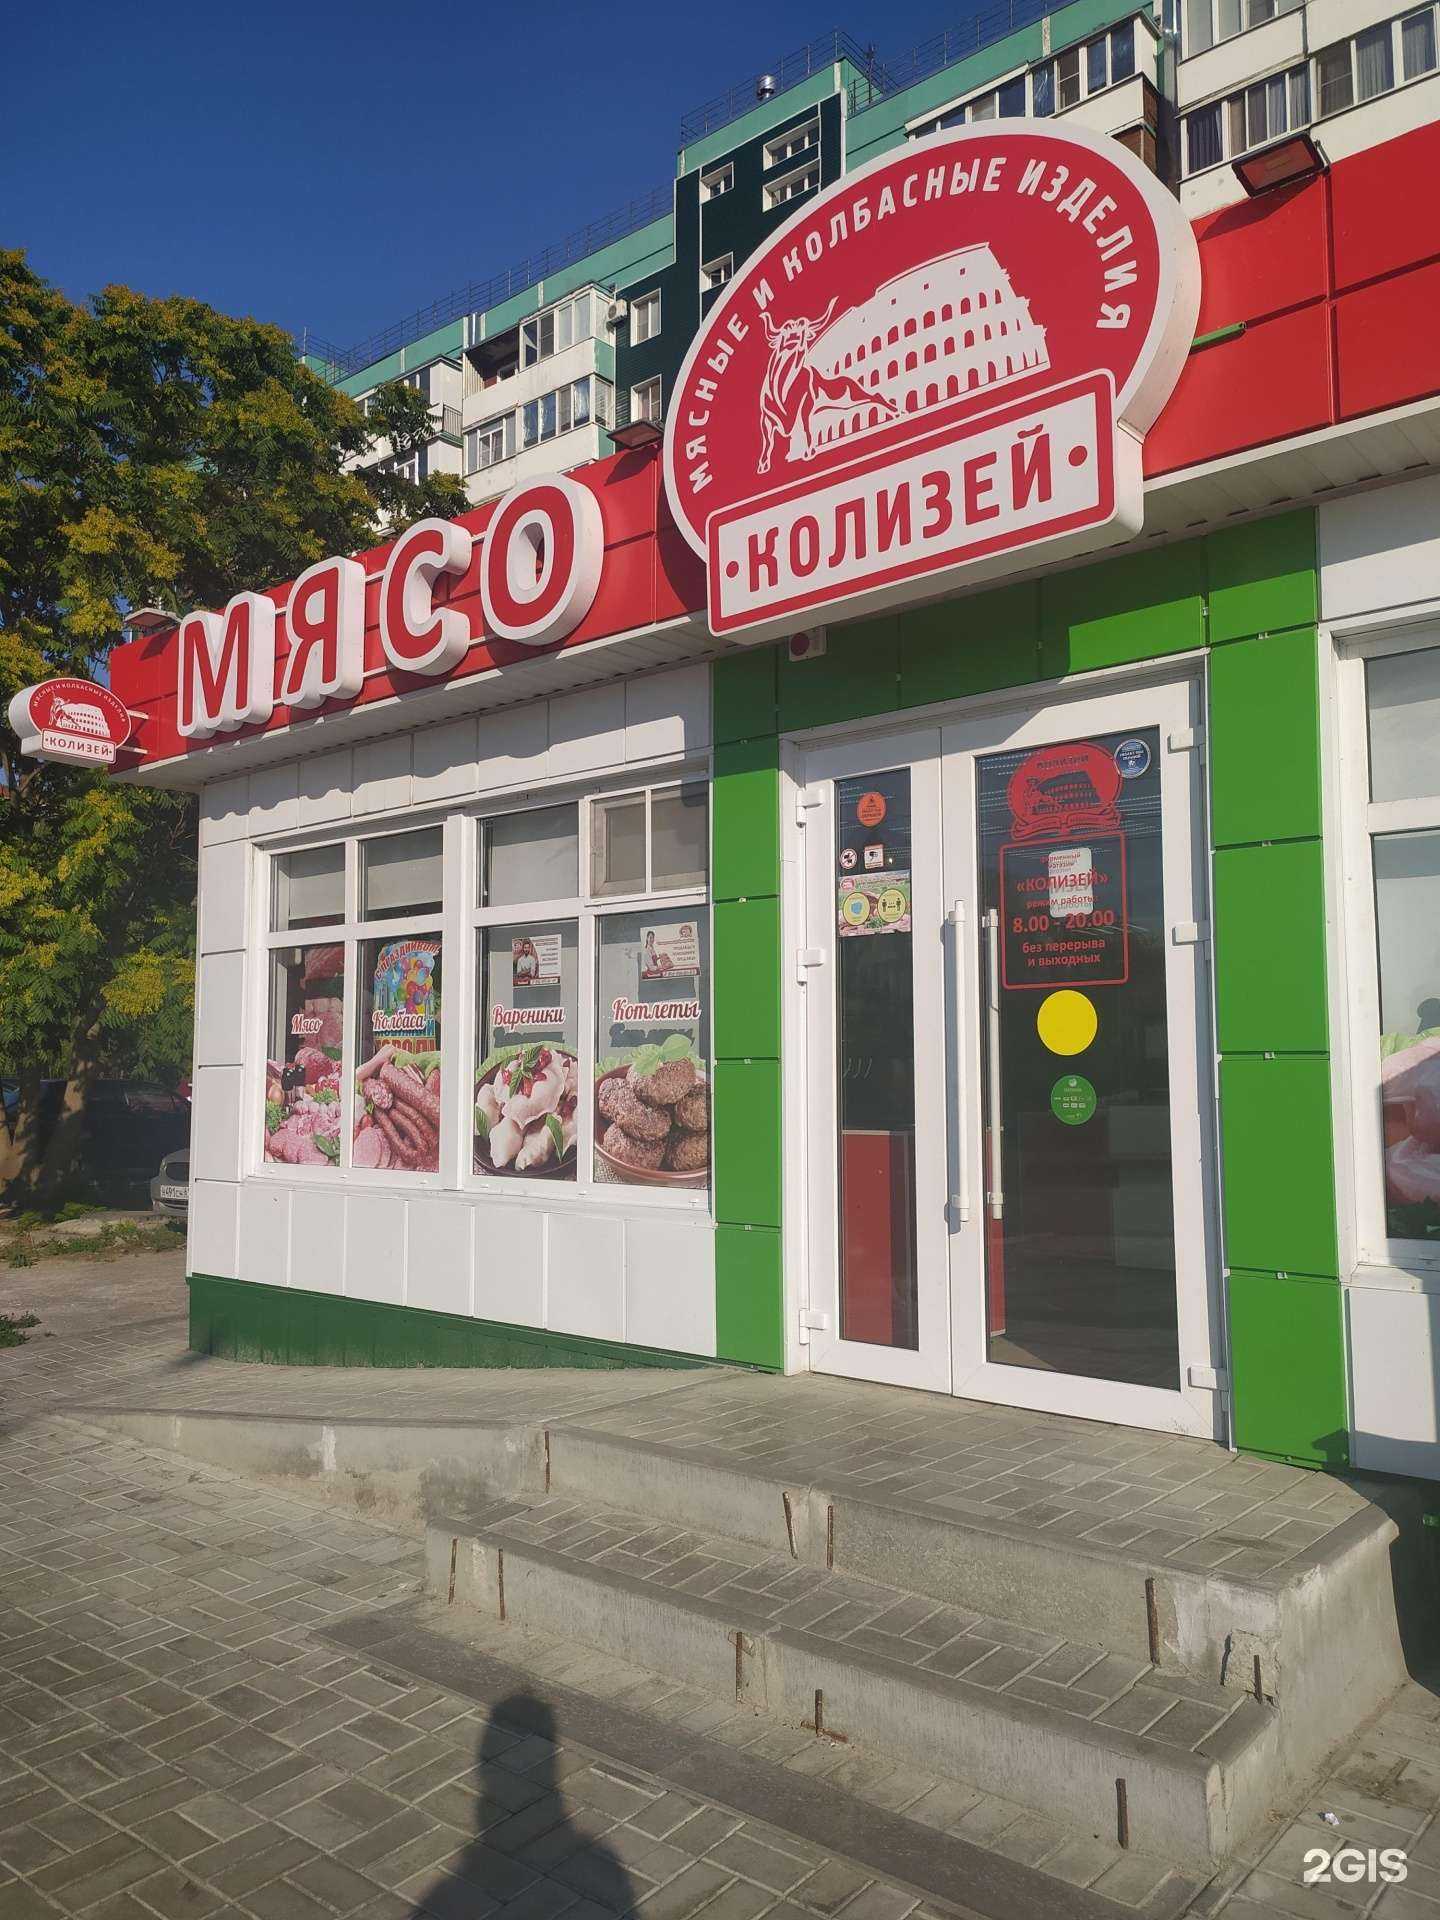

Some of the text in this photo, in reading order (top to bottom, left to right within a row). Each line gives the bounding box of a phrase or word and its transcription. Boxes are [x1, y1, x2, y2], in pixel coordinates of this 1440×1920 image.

[685, 157, 1138, 493] МЯСНЫЕ И КОЛБАСНЫЕ ИЗДЕЛИЯ
[747, 423, 1053, 593] КОЛИЗЕЙ
[178, 473, 604, 739] МЯСО
[49, 736, 110, 756] КОЛИЗЕЙ
[1012, 915, 1049, 933] 8.00
[1022, 939, 1105, 954] без перерыва
[1028, 954, 1101, 968] и выходных
[372, 1009, 426, 1032] Колбаса
[493, 1005, 566, 1031] Вареники
[612, 998, 702, 1022] Котлеты
[291, 1014, 323, 1034] Мясо
